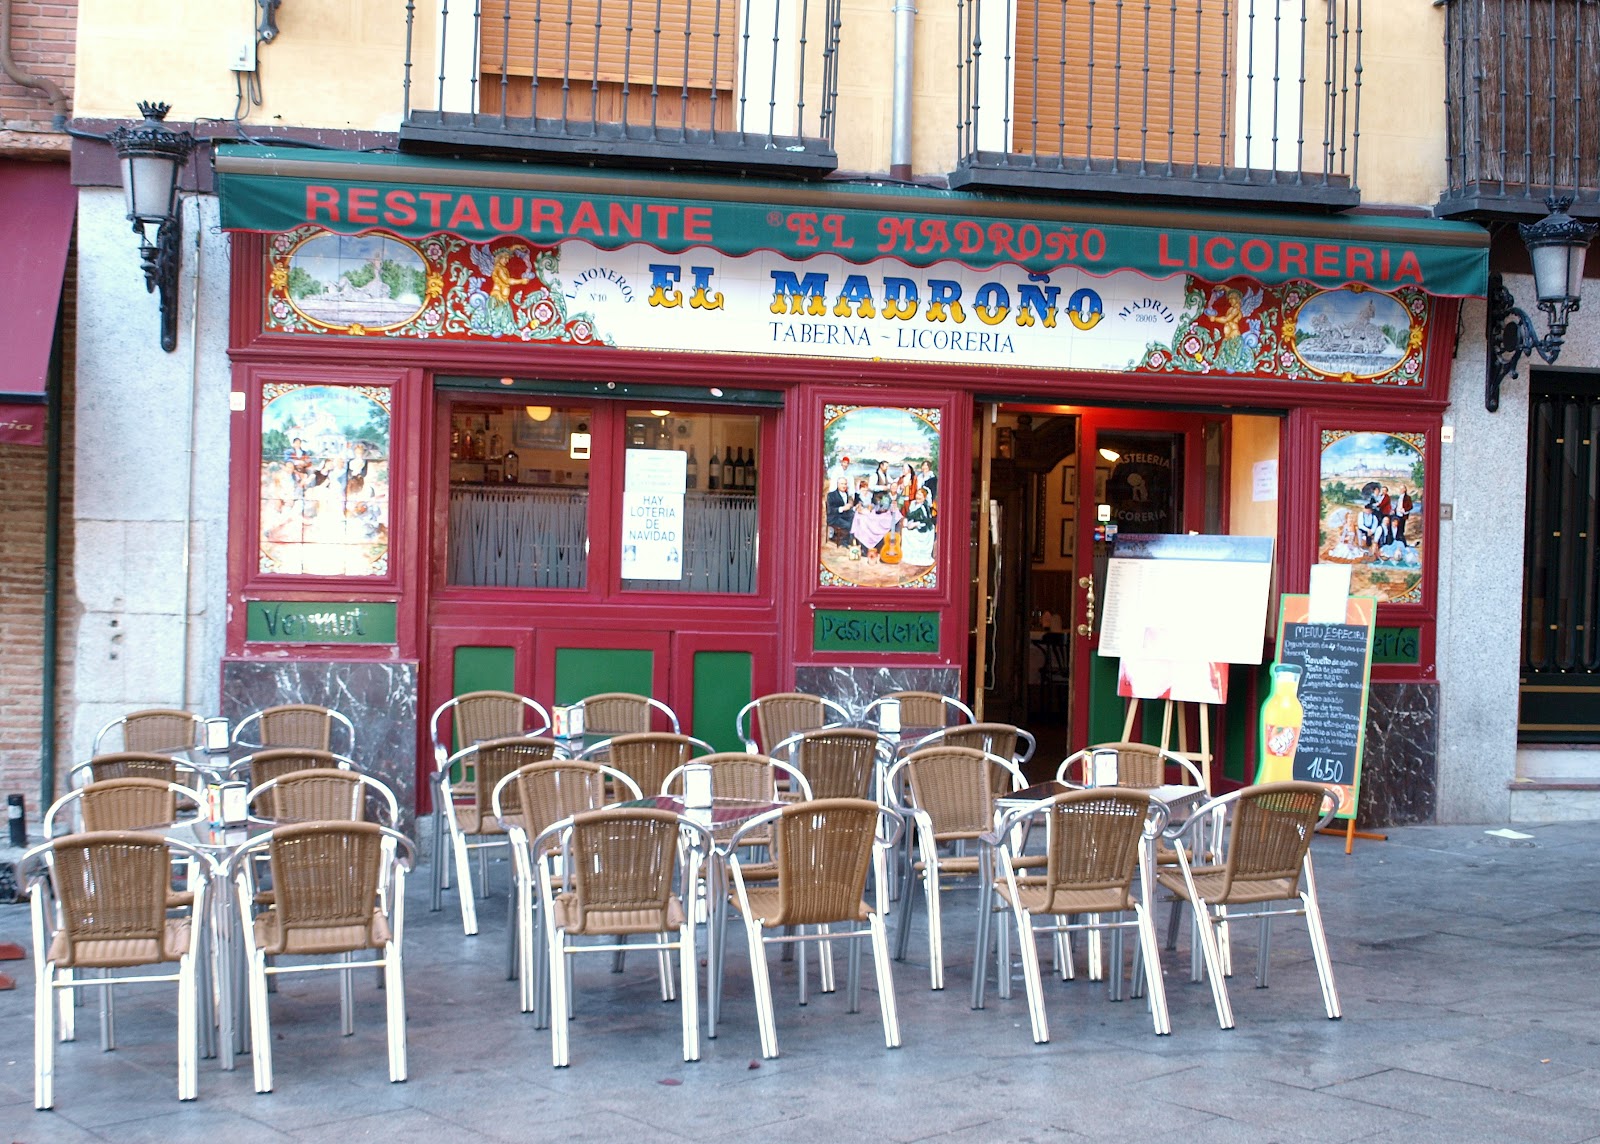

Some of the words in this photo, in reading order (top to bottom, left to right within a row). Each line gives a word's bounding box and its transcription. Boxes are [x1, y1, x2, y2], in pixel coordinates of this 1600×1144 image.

[306, 185, 713, 242] RESTAURANTE
[786, 212, 855, 248] EL
[877, 217, 1106, 261] MADROÑO
[1158, 233, 1425, 283] LICORERIA
[565, 267, 636, 304] LATONEROS
[648, 264, 724, 311] EL
[769, 270, 1105, 331] MADROÑO
[1118, 297, 1175, 324] MADRID
[1135, 313, 1158, 323] 28005
[769, 321, 872, 346] TABERNA
[897, 328, 1016, 354] LICORERIA
[1115, 453, 1170, 468] ASTELERIA
[643, 495, 664, 506] HAY
[630, 506, 676, 518] LOTERIA
[1111, 509, 1167, 522] ICORERIA
[645, 518, 660, 530] DE
[629, 530, 676, 542] NAVIDAD
[1294, 626, 1324, 639] MENU
[1324, 627, 1367, 642] ESPECIAL
